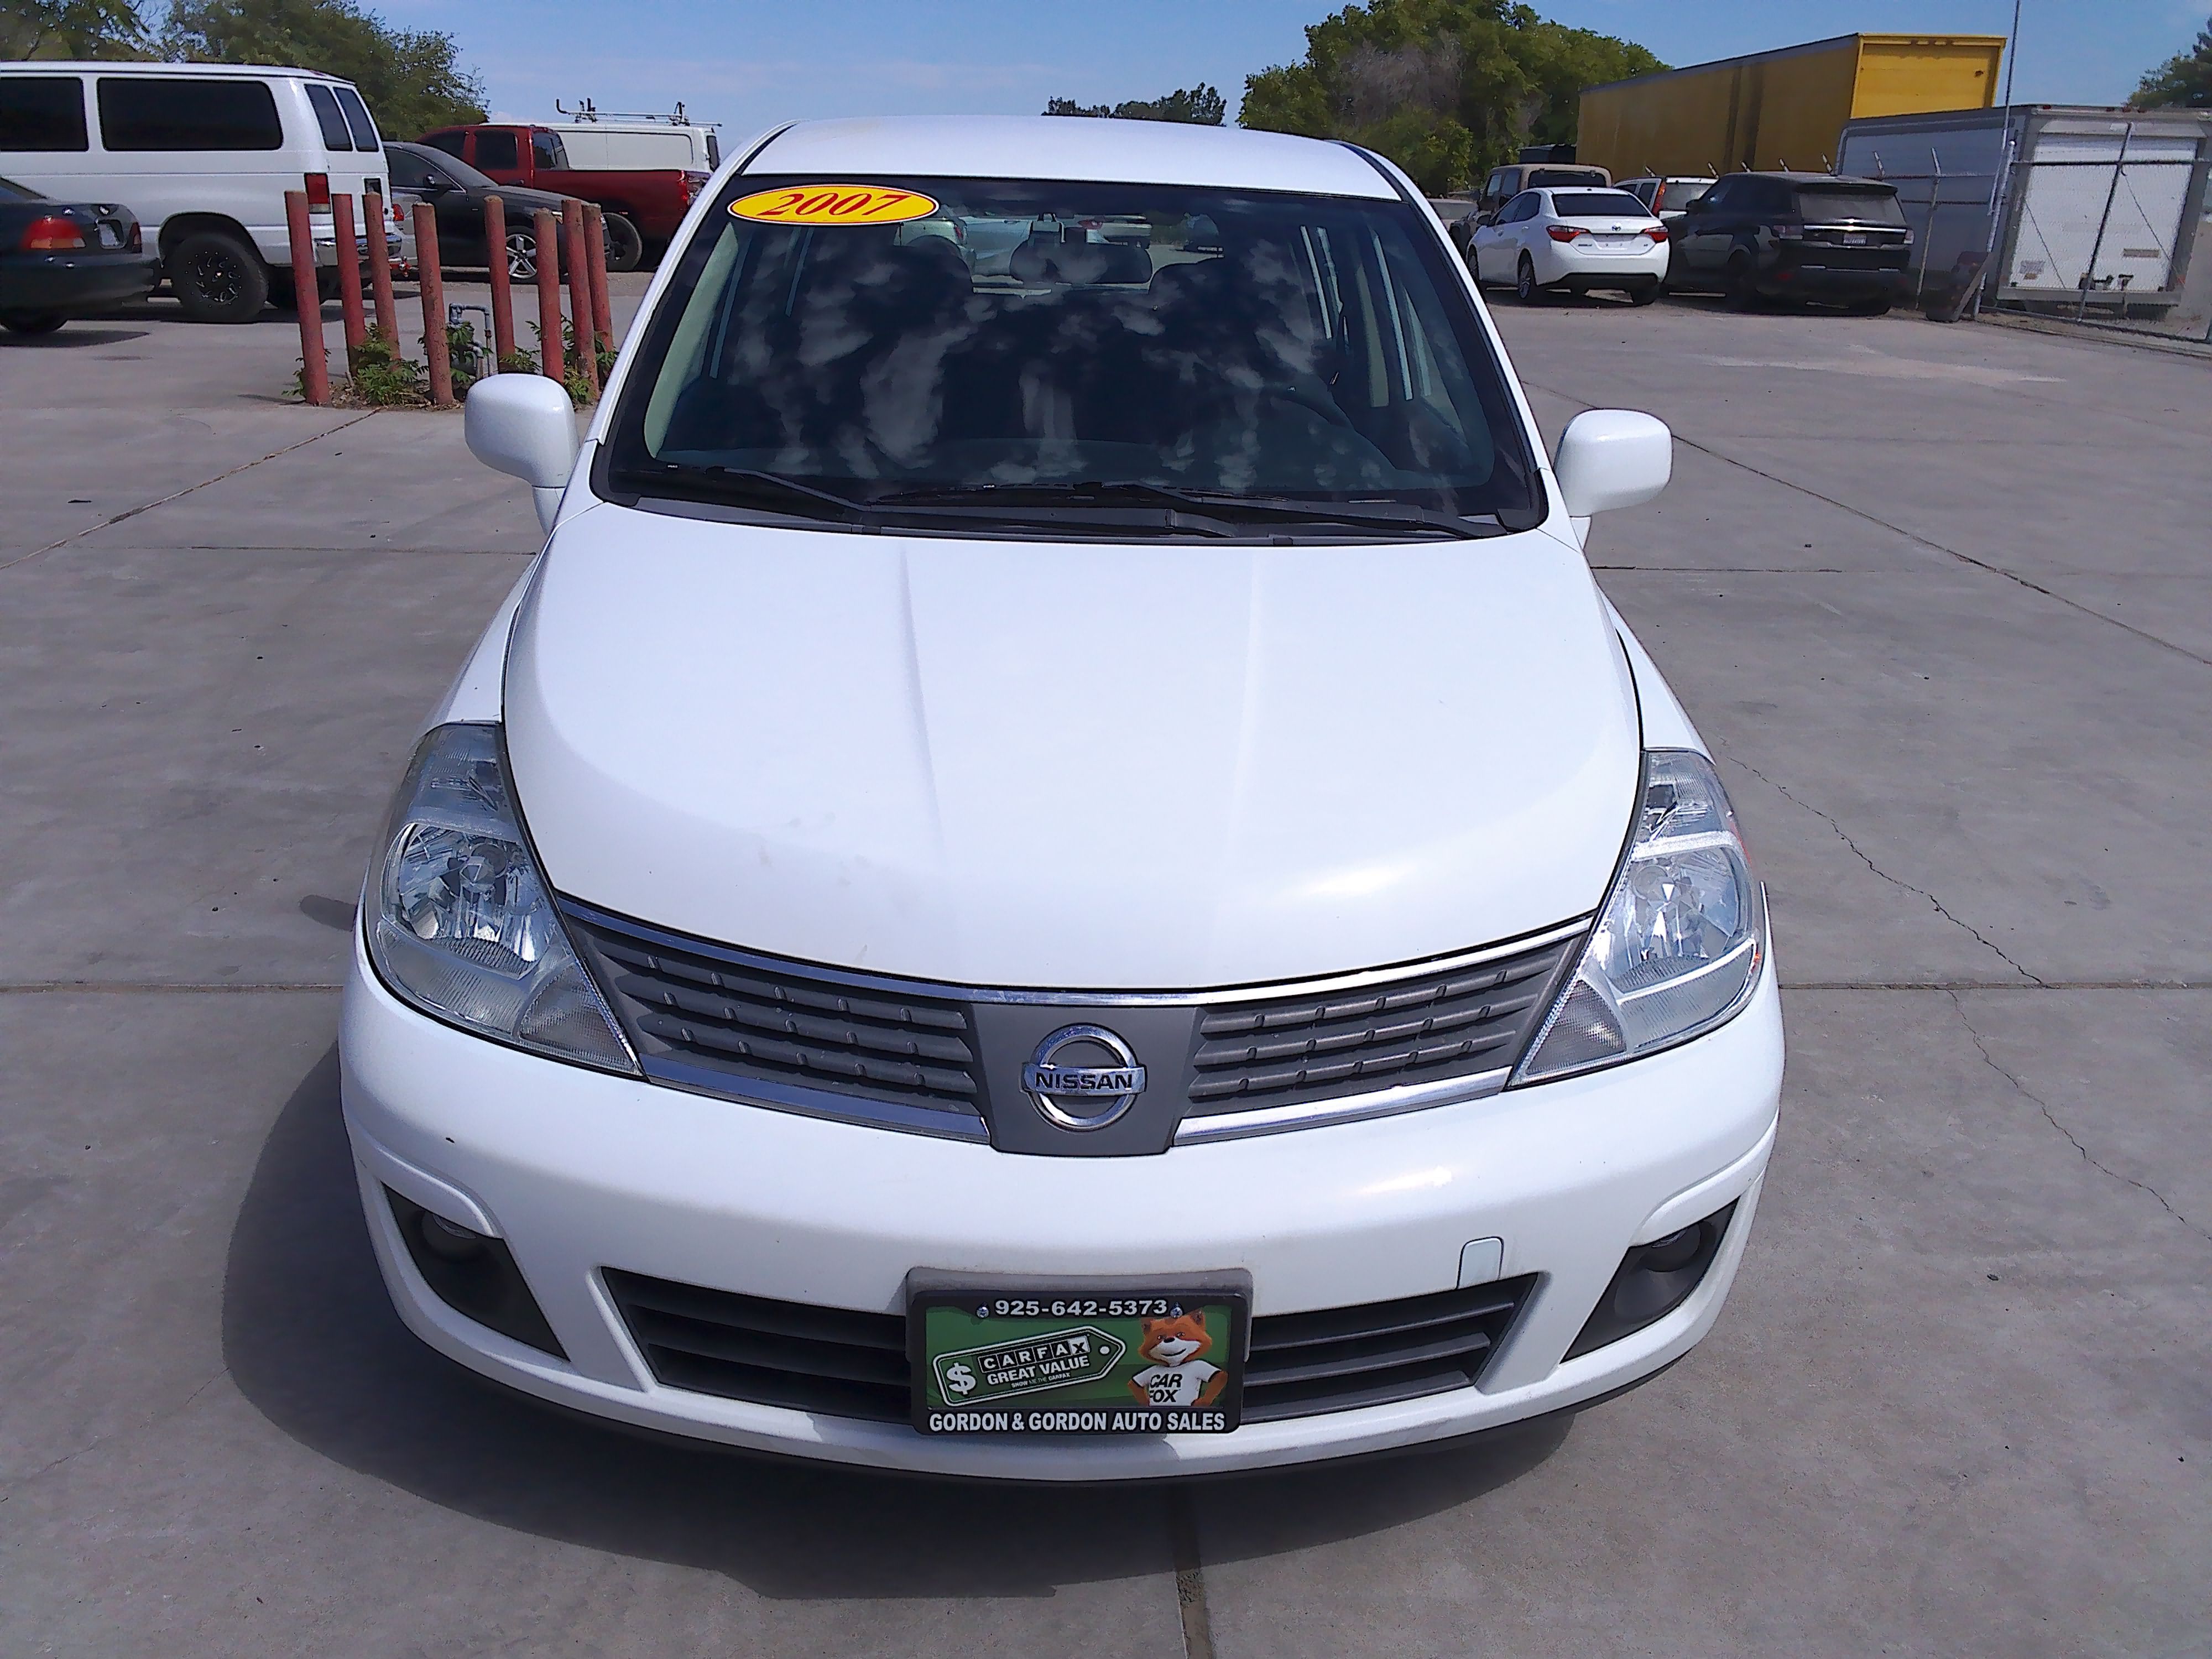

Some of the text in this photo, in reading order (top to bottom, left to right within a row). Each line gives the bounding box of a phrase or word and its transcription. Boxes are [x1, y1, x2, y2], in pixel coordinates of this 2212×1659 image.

[755, 192, 912, 216] 2007
[1035, 1071, 1133, 1090] NISSAN
[995, 1300, 1167, 1316] 925-642-5373
[982, 1340, 1087, 1370] CARFAX
[987, 1356, 1090, 1385] GREAT VALUE
[1011, 1380, 1028, 1389] SHOW
[1048, 1372, 1071, 1381] CARFAX
[1150, 1373, 1183, 1389] CAR
[1149, 1389, 1177, 1402] FOX
[930, 1412, 1225, 1431] GORDON & GORDON AUTO SALES
